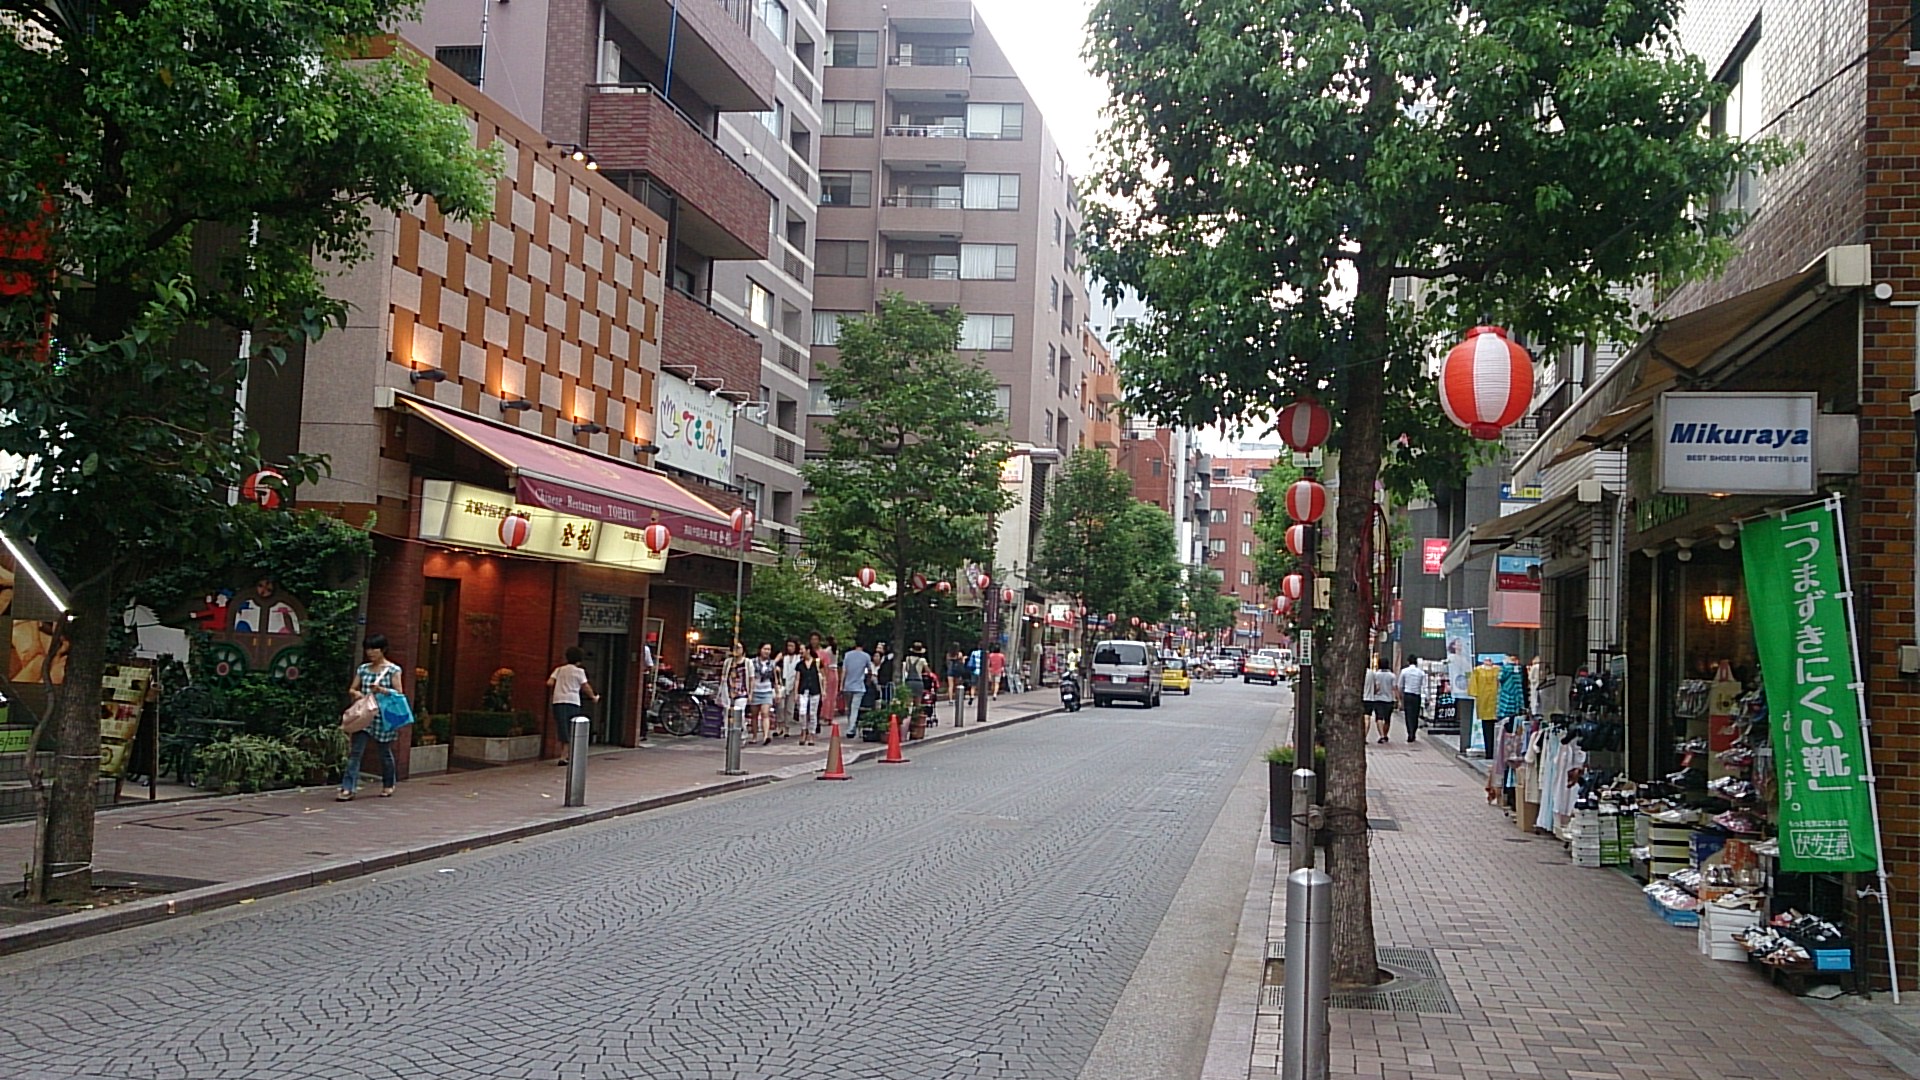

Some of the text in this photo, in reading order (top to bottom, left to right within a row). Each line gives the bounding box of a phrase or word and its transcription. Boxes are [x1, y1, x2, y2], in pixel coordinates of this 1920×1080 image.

[683, 411, 727, 457] てもみん
[1670, 423, 1808, 448] Mikuraya
[535, 488, 563, 506] Chinese
[567, 495, 602, 515] Restaurant
[1781, 521, 1852, 791] 「つまずきにくい靴」
[1795, 832, 1849, 857] 快歩主義
